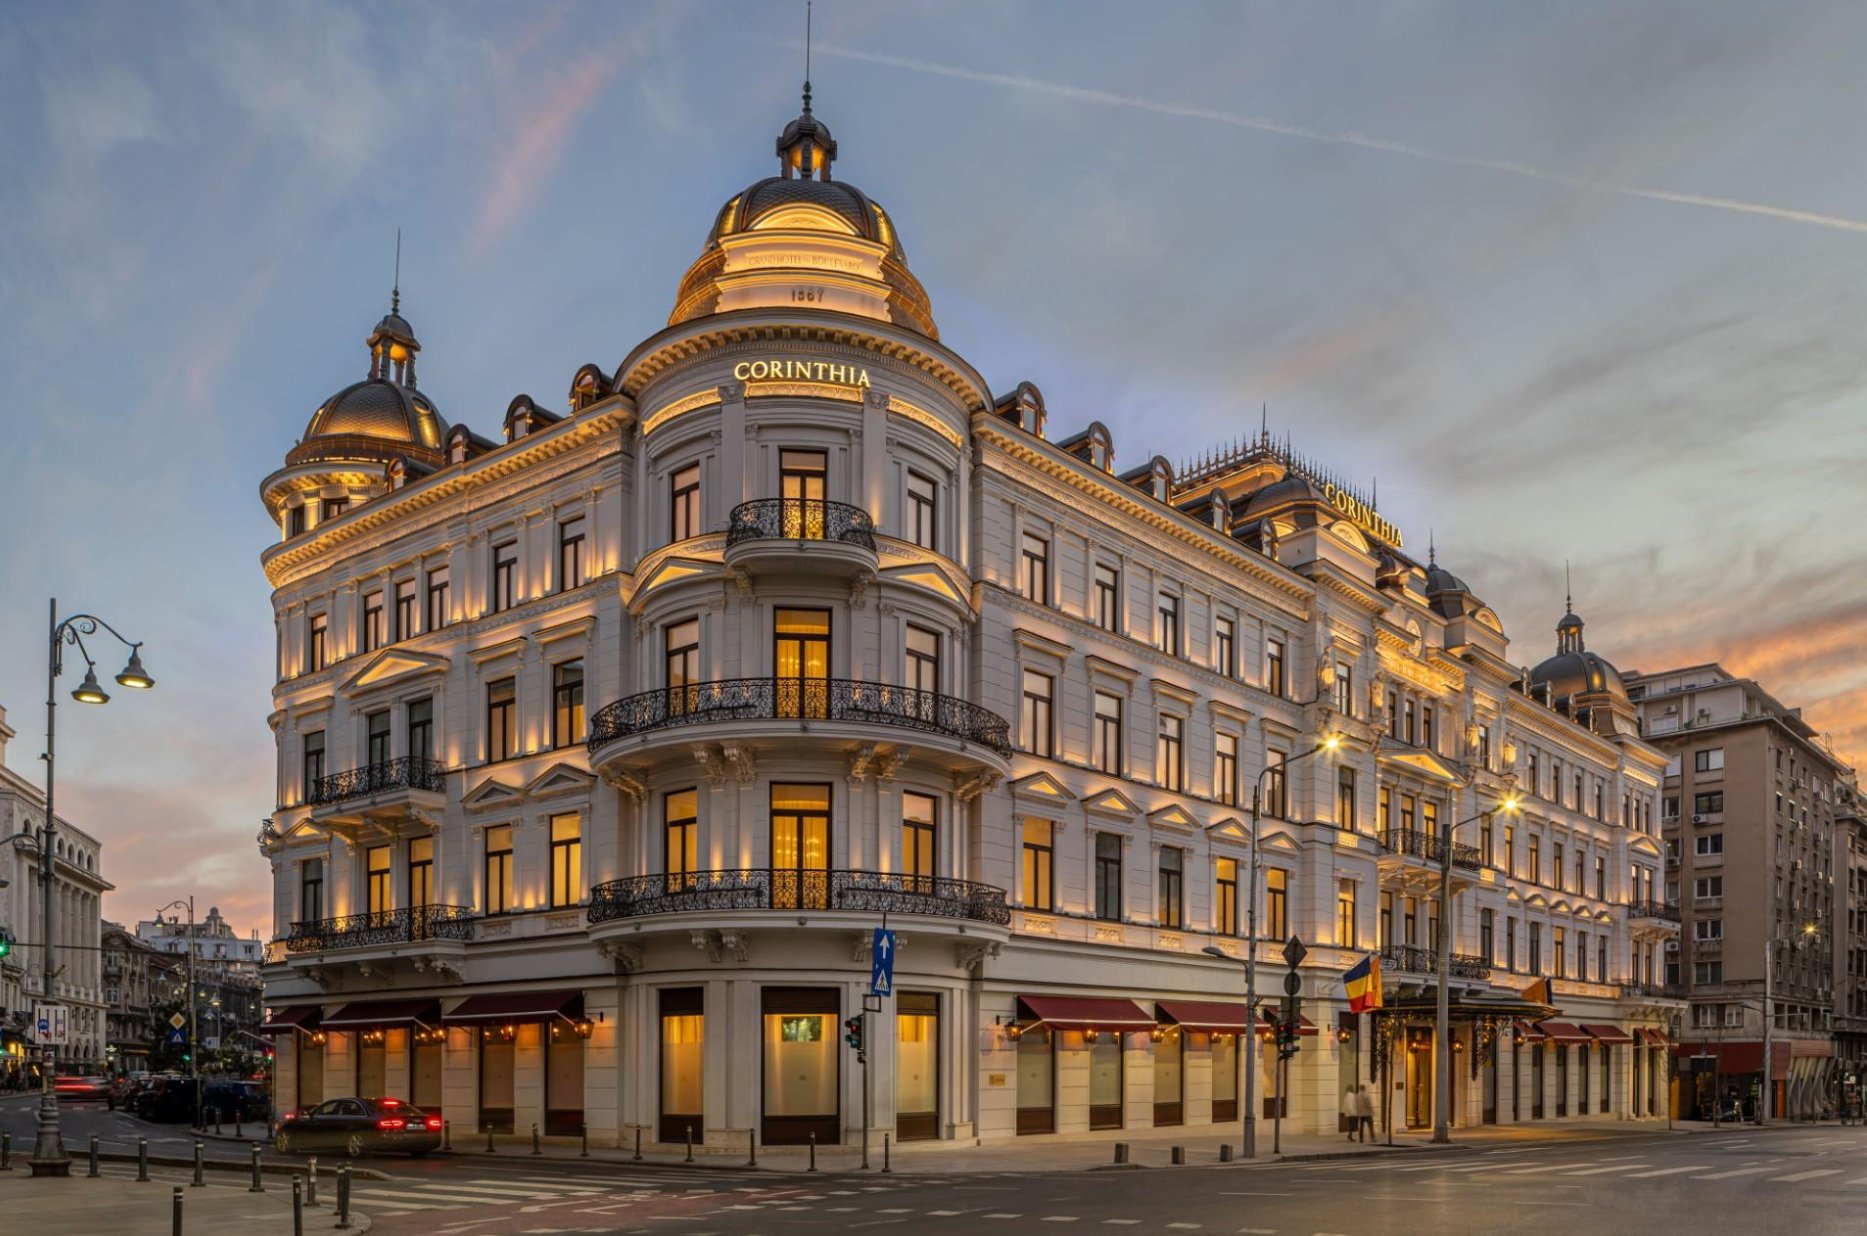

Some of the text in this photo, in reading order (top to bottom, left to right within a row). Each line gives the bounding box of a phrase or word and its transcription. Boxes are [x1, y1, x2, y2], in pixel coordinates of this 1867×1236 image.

[791, 288, 825, 303] 1867
[734, 360, 872, 388] CORINTHIA
[1325, 483, 1404, 548] CORINTHIA
